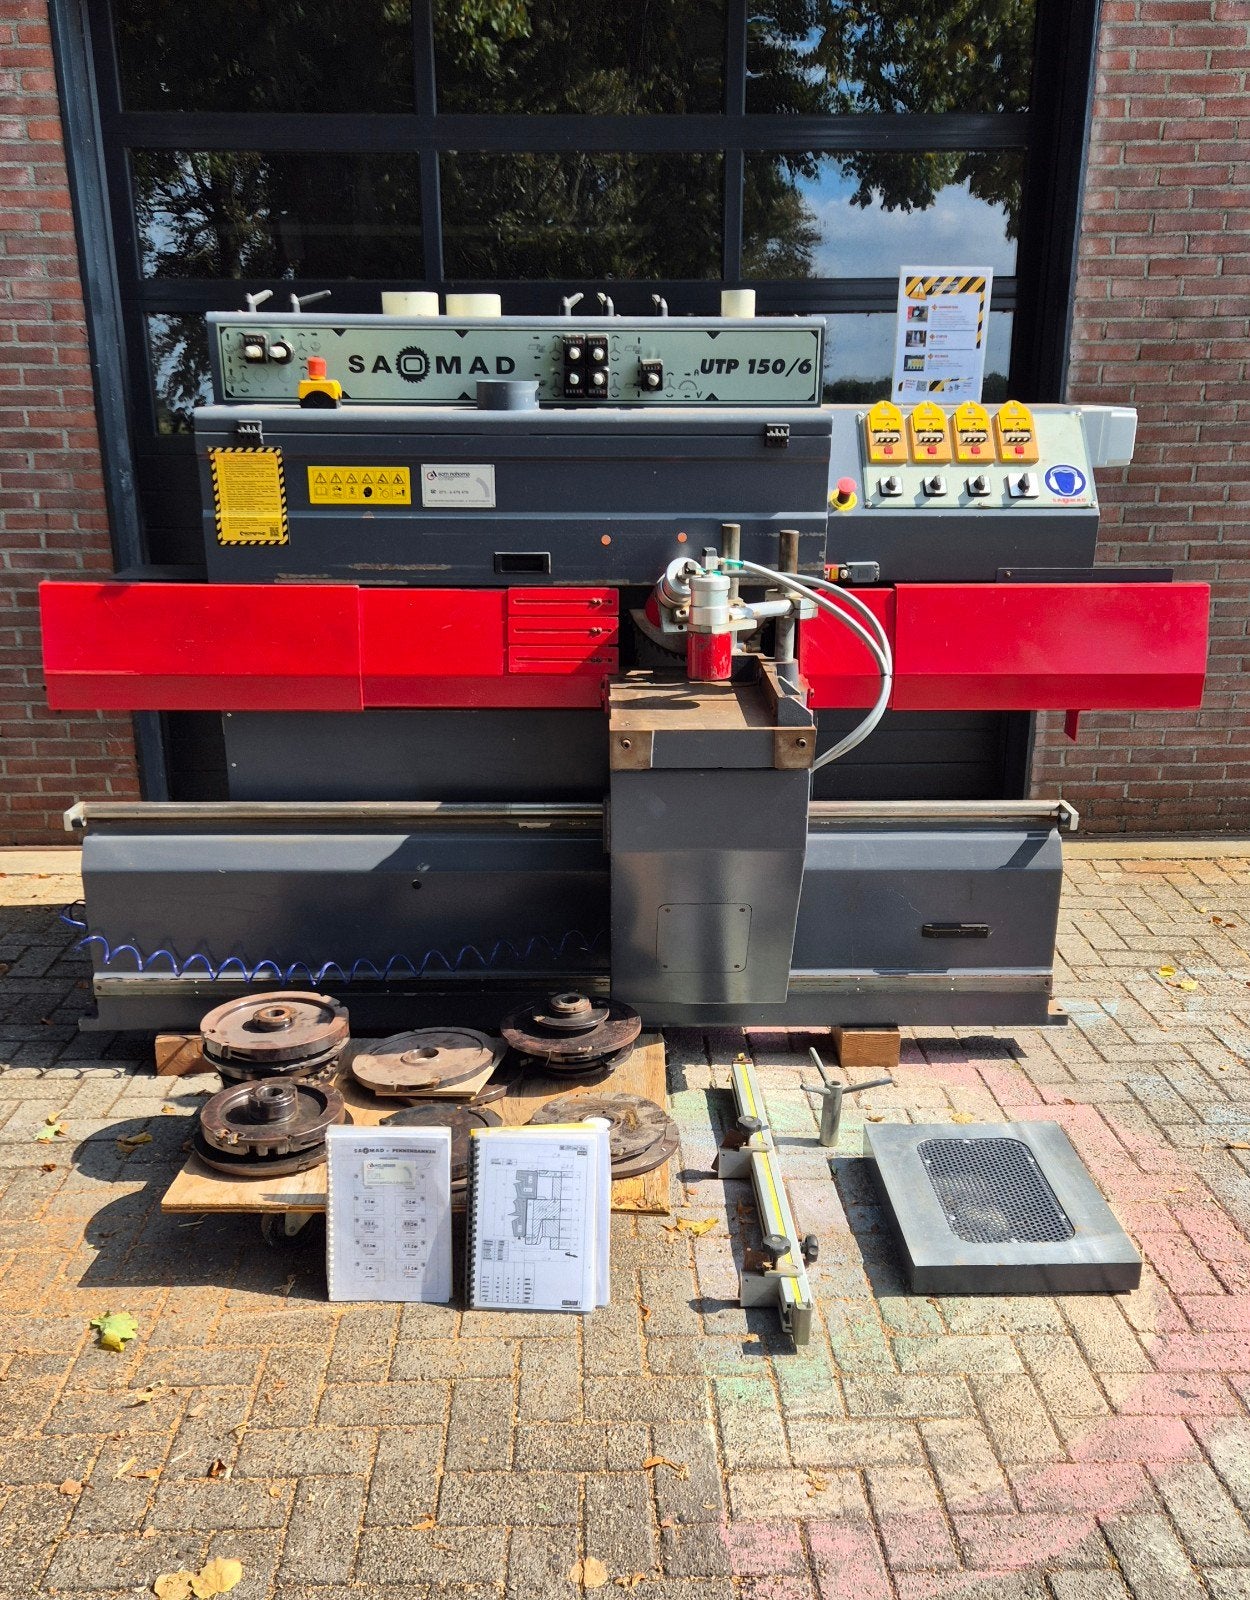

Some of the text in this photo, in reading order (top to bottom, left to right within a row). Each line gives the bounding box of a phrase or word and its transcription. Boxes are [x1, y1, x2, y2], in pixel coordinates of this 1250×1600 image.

[700, 358, 812, 377] UTP 150/6
[696, 391, 703, 399] V
